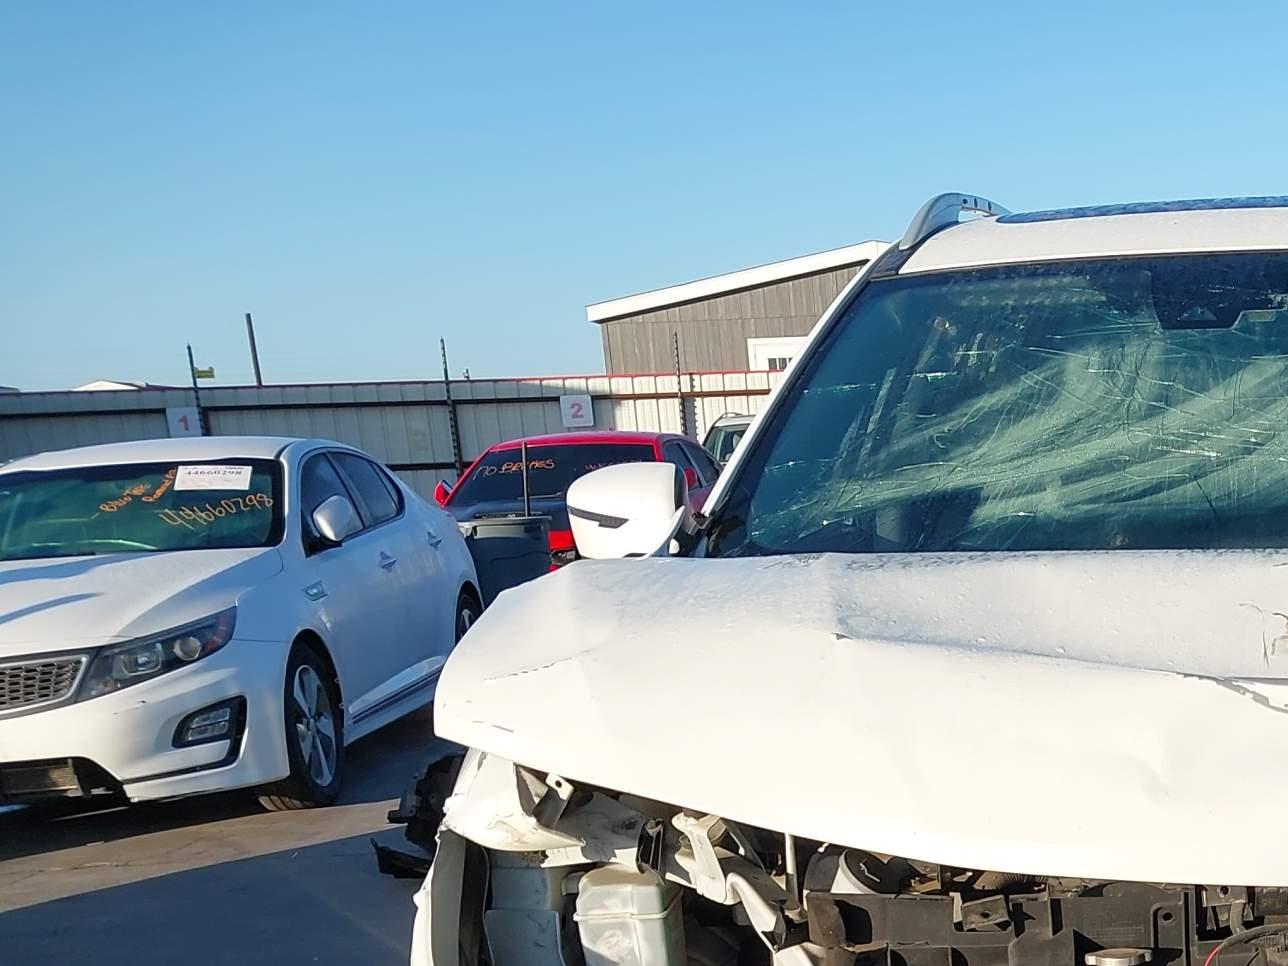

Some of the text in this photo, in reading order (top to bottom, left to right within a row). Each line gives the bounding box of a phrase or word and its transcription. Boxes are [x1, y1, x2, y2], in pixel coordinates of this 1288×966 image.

[570, 402, 584, 419] 2
[178, 415, 189, 431] 1
[159, 493, 273, 530] 44660298
